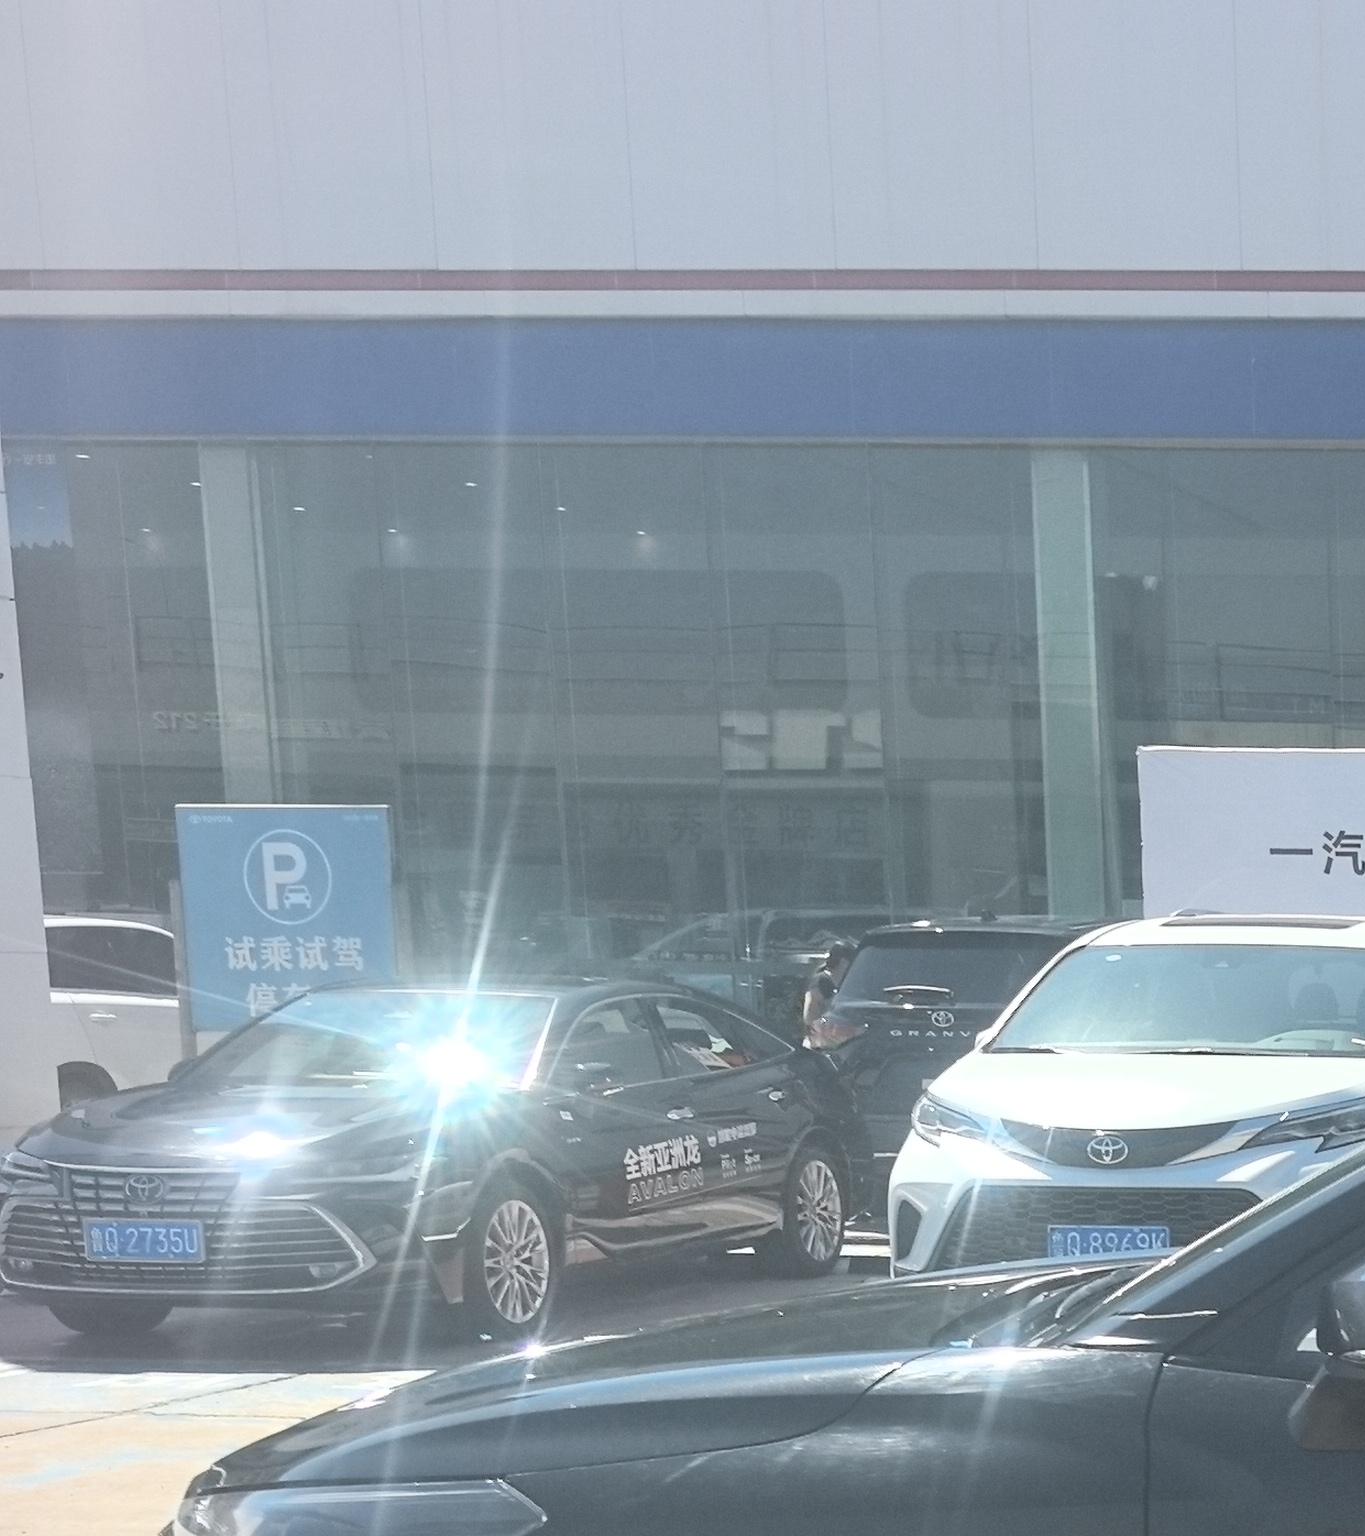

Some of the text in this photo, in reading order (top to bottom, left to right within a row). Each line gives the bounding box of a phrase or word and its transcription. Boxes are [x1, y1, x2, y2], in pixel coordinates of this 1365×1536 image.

[225, 935, 364, 971] 试乘试驾
[624, 1134, 702, 1181] 全新亚洲龙
[627, 1166, 705, 1205] AVALON
